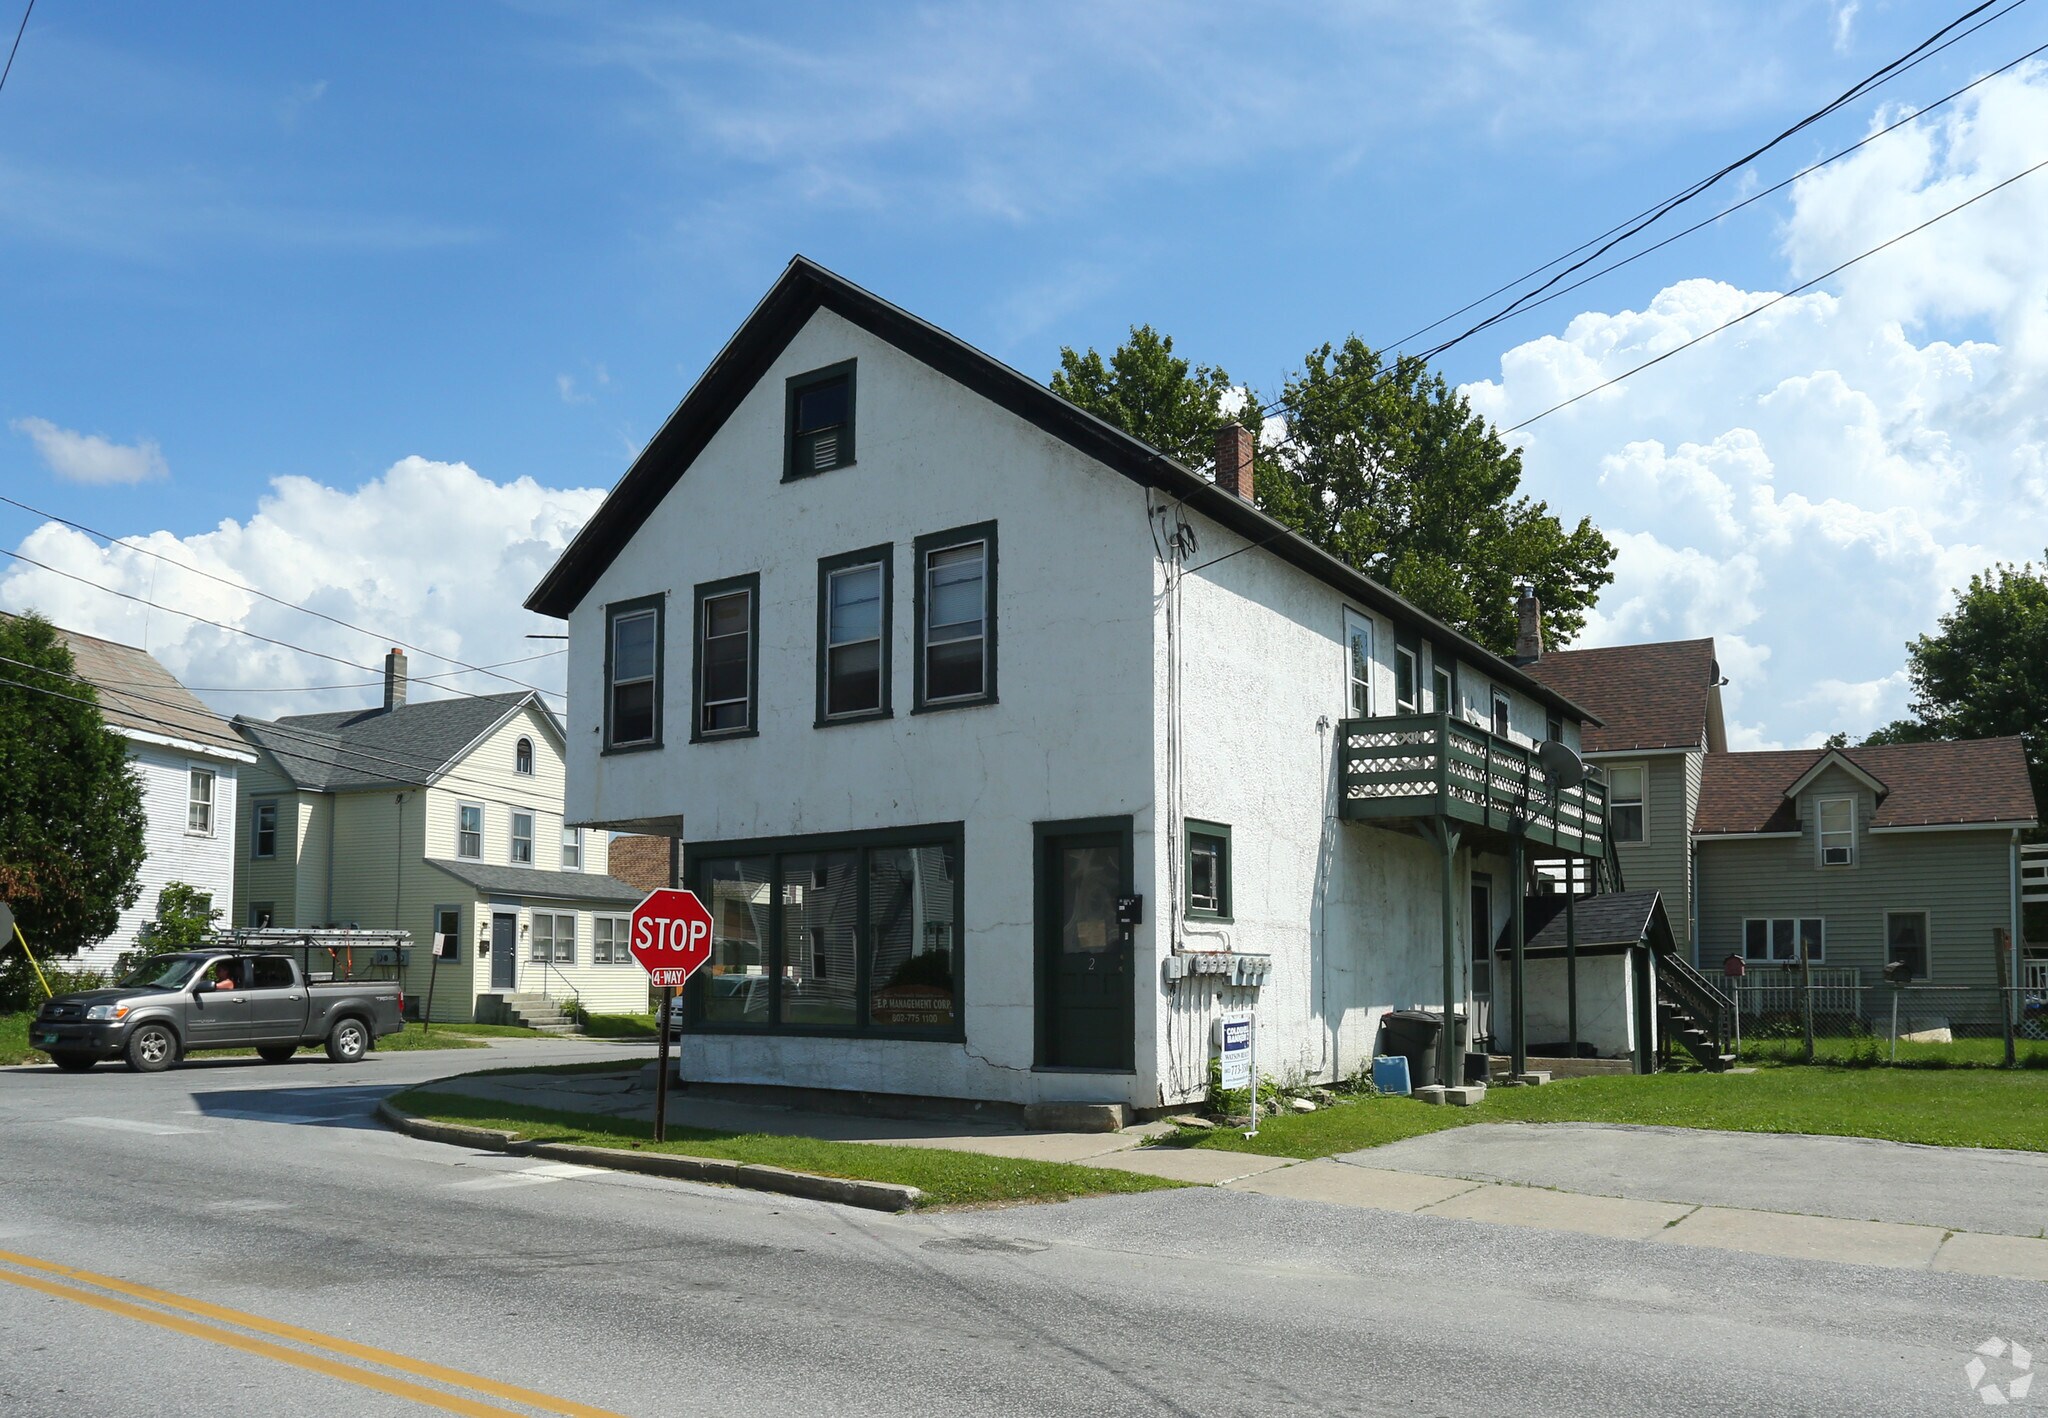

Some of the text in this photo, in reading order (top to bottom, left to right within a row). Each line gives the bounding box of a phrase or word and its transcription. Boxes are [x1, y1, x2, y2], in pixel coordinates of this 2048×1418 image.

[635, 916, 707, 952] STOP
[1088, 957, 1095, 970] 2
[653, 970, 683, 985] 4-WAY
[889, 999, 932, 1009] MANAGEMENT
[933, 999, 953, 1010] CORP.
